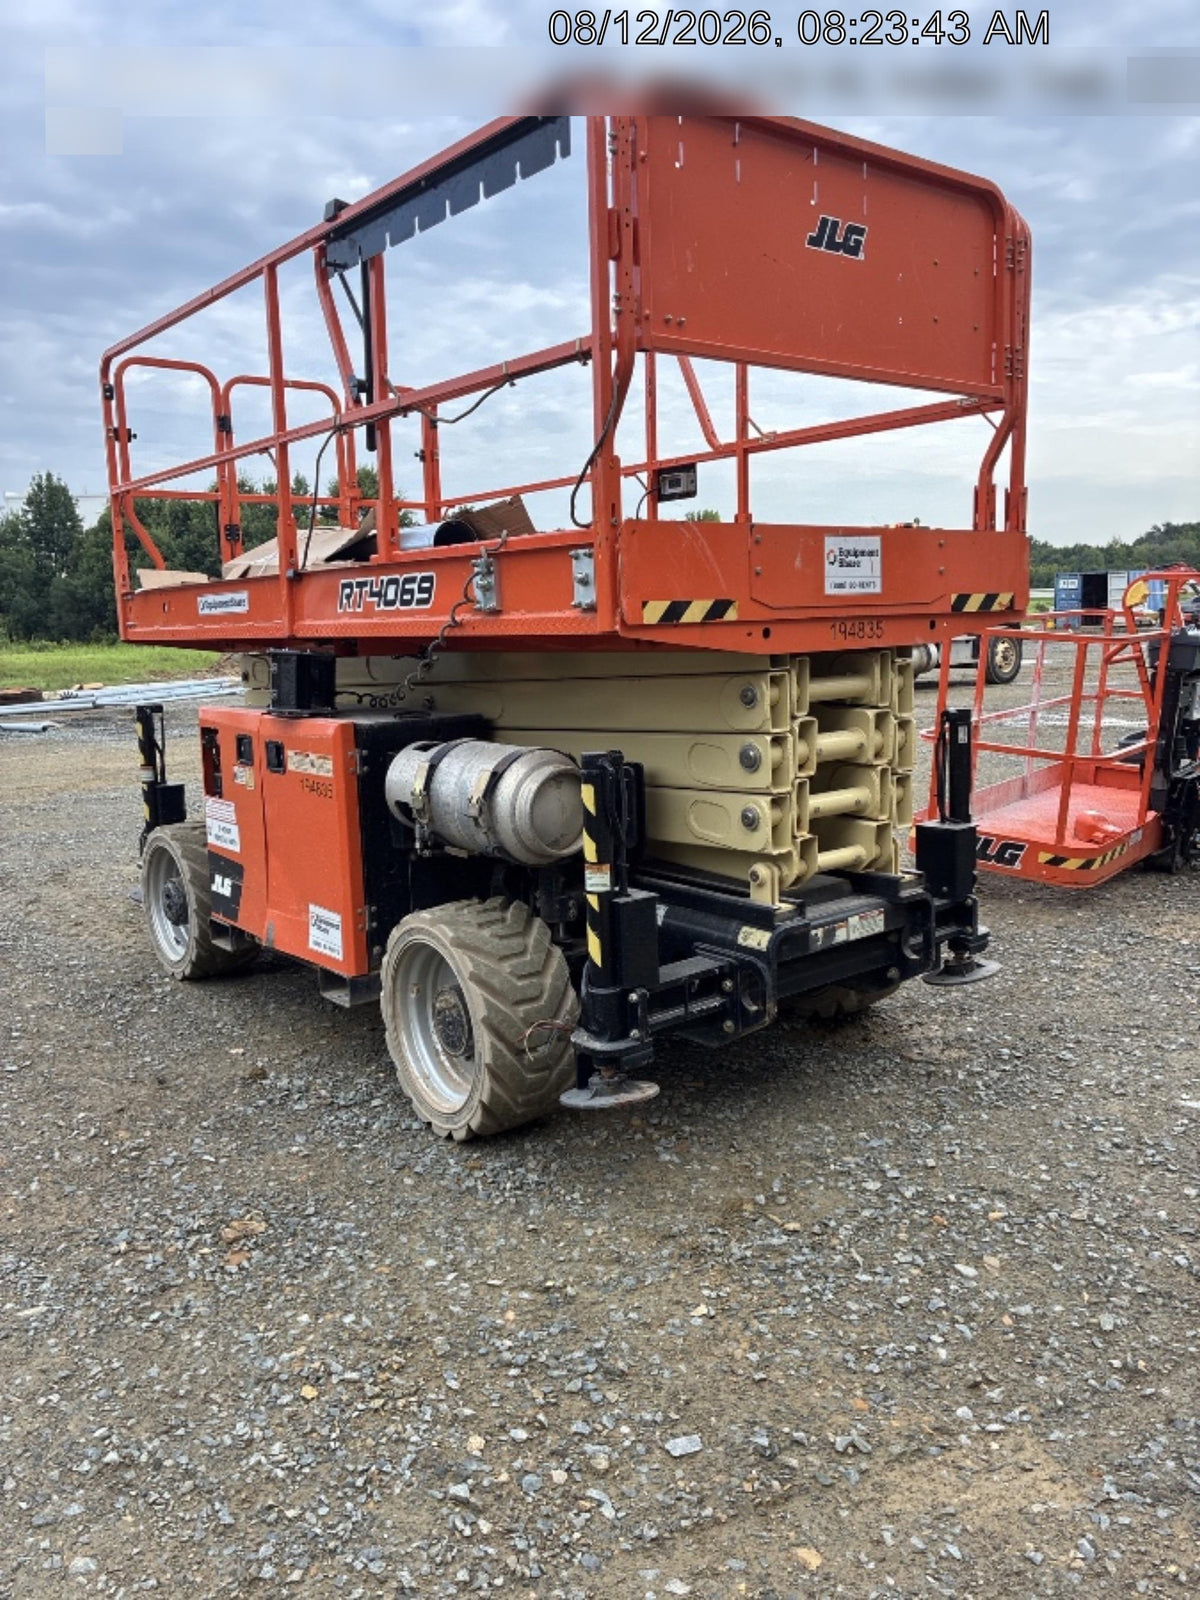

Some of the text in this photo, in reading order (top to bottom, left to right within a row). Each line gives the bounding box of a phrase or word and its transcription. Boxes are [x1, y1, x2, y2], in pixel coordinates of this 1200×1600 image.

[805, 214, 868, 260] JLG
[838, 547, 880, 559] Equipment
[337, 571, 436, 613] RT4069
[829, 620, 884, 640] 194835
[976, 836, 1029, 870] LG
[211, 873, 232, 898] JLG
